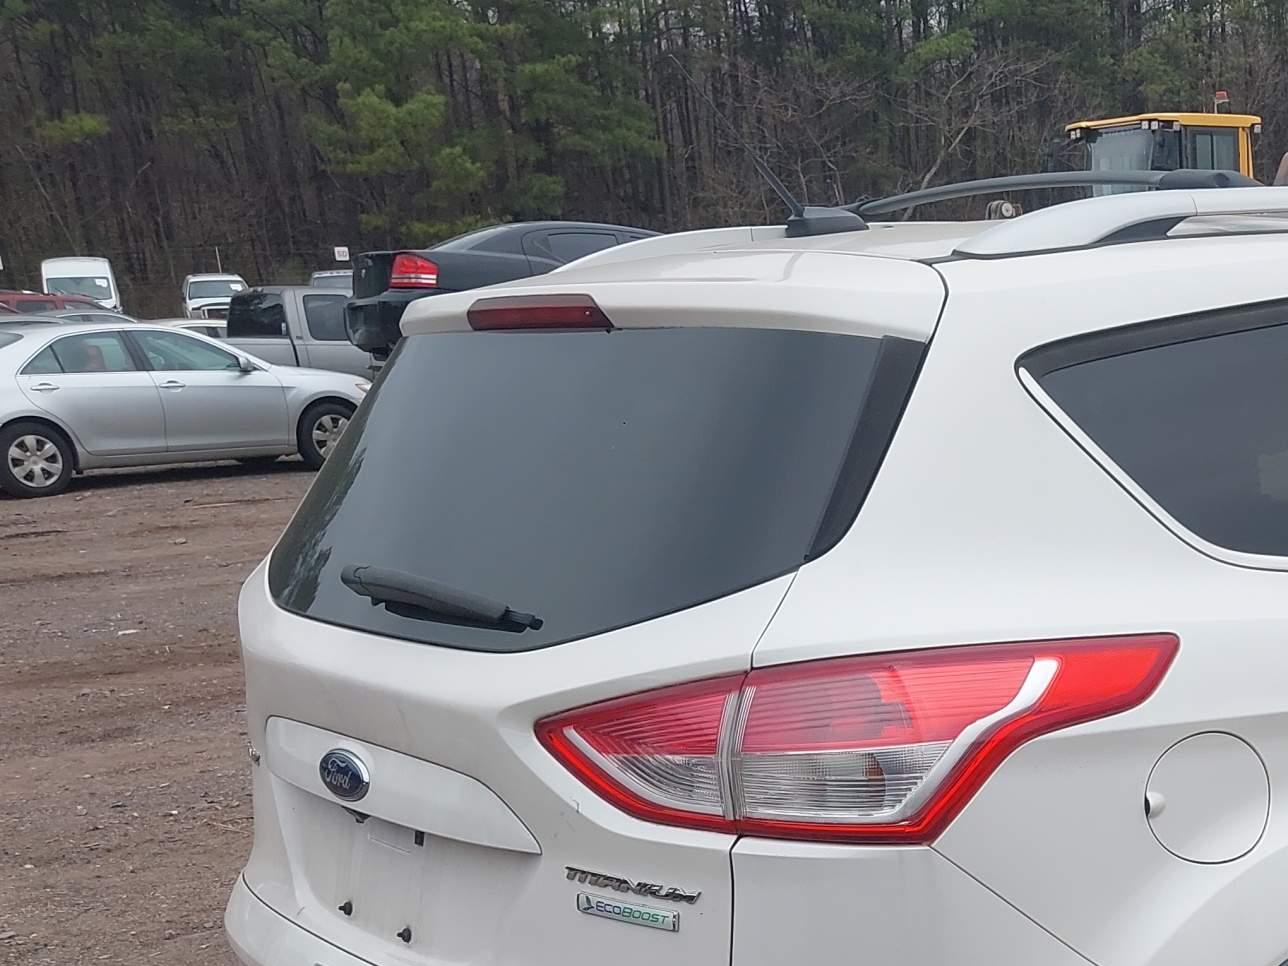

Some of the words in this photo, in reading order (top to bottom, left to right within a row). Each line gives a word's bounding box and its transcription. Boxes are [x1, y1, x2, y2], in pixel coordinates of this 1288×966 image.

[325, 757, 351, 790] Ford
[565, 866, 702, 905] TITANIUM
[596, 900, 670, 925] ECOBOOST
